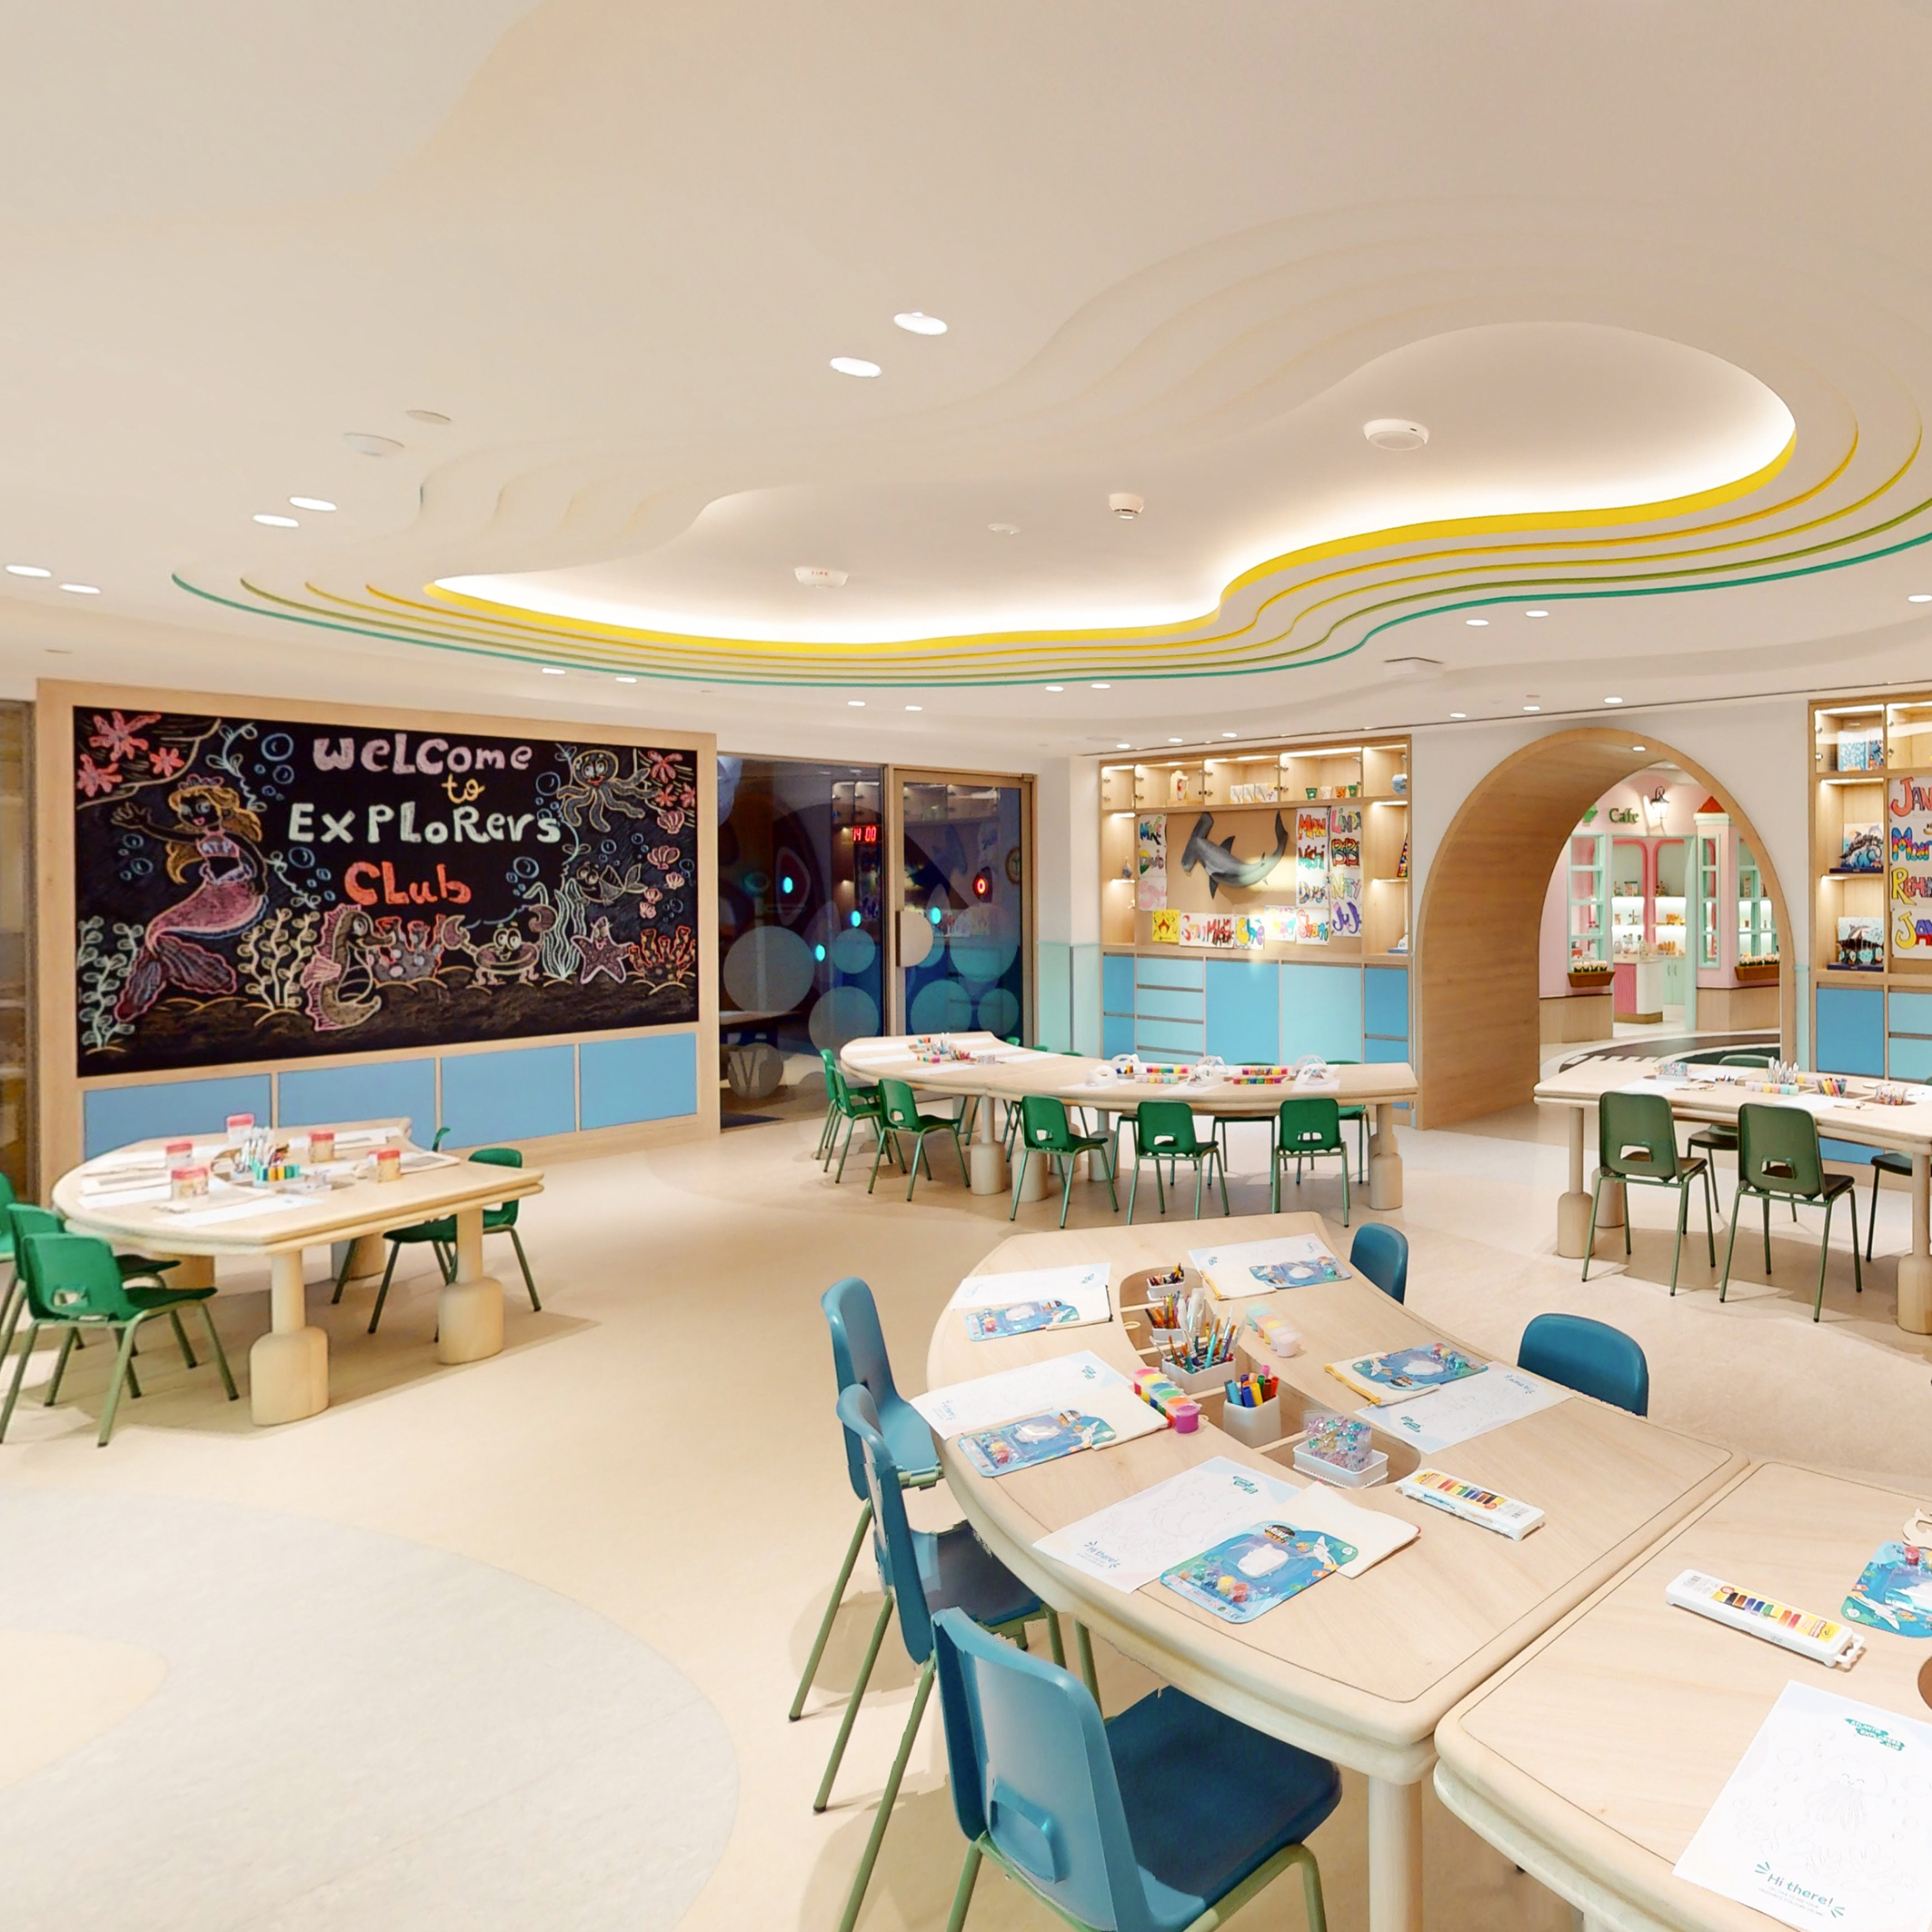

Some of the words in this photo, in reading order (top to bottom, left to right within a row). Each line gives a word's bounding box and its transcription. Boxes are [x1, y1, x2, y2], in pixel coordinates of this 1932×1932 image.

[441, 773, 486, 803] to
[1608, 807, 1639, 824] Cafe
[1768, 1874, 1785, 1887] Hi
[1787, 1881, 1834, 1907] there!
